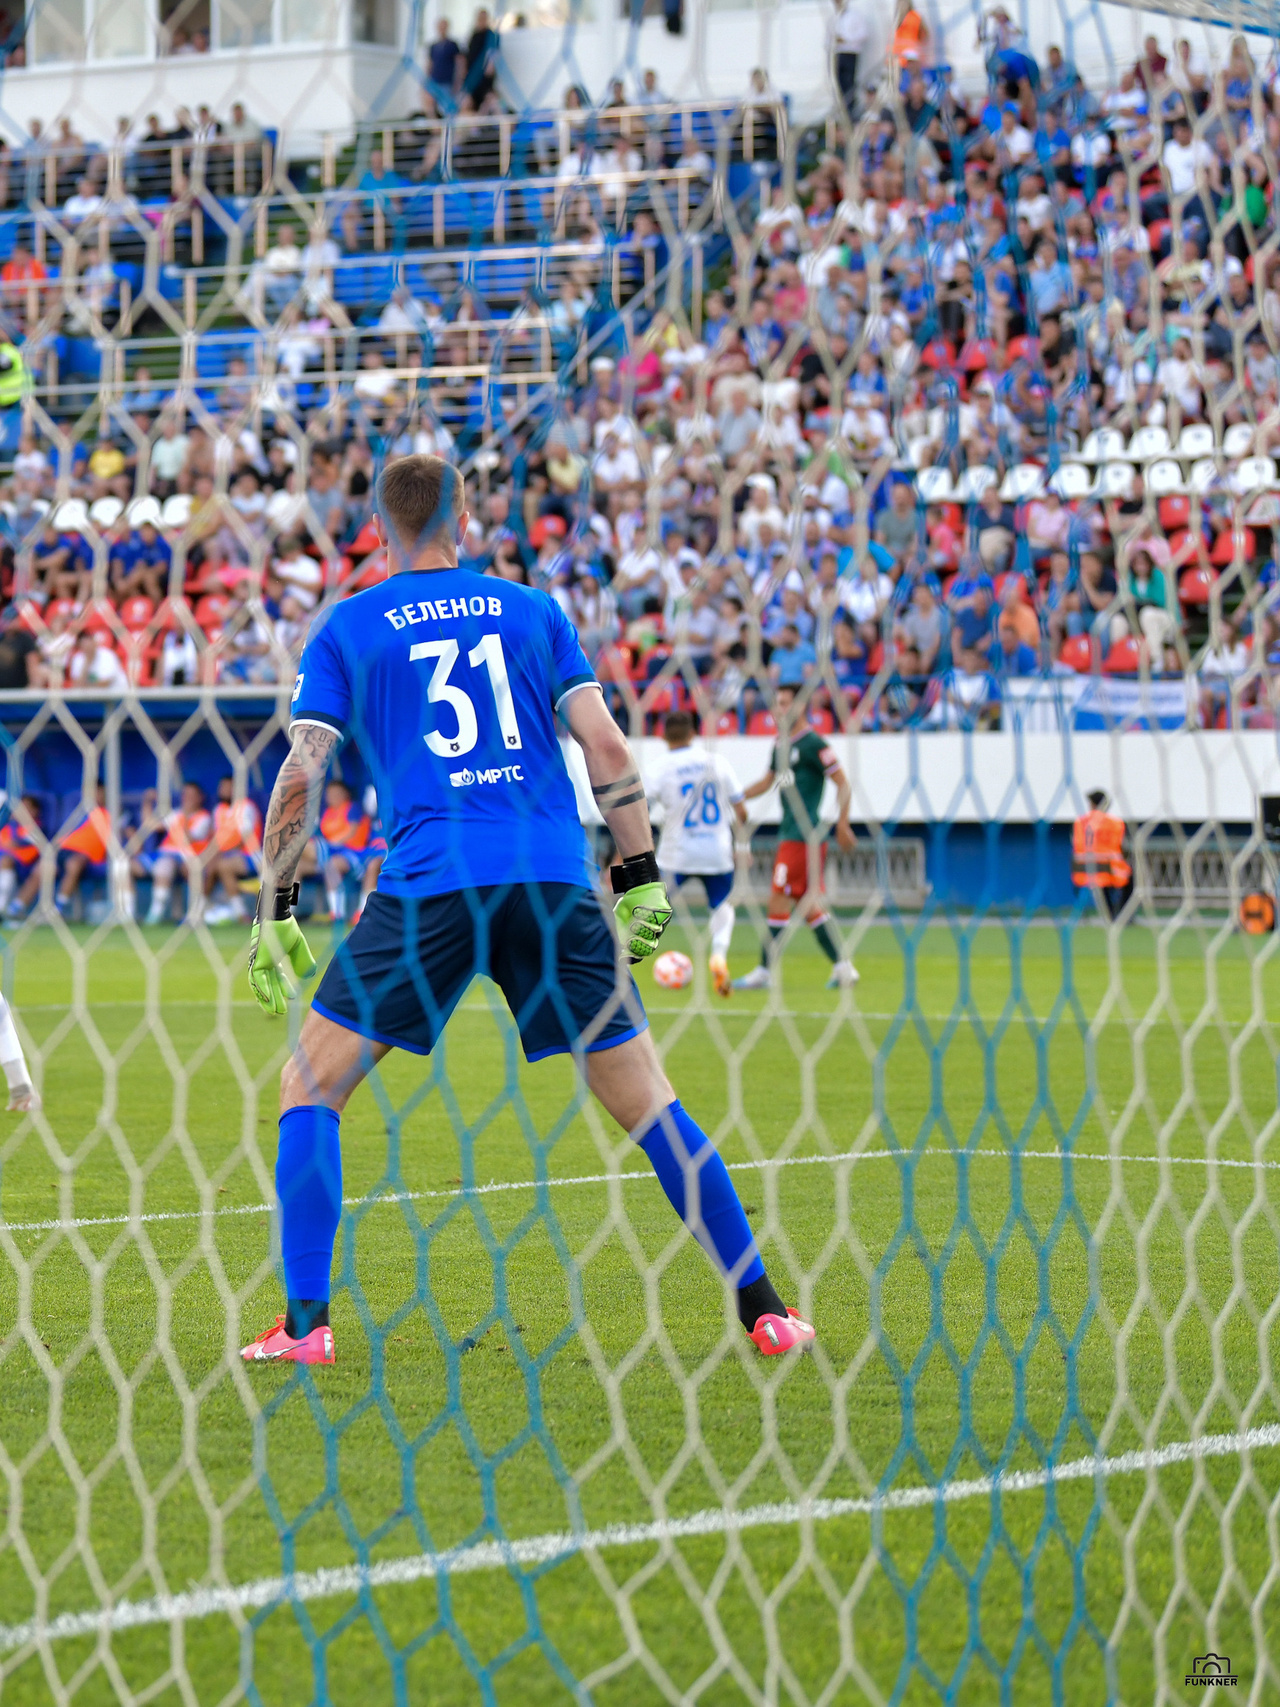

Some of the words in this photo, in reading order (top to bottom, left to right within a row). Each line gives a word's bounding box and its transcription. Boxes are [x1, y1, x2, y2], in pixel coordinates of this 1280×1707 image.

[383, 596, 503, 631] БЕЛЕНОВ
[408, 633, 523, 758] 31
[681, 781, 721, 828] 28
